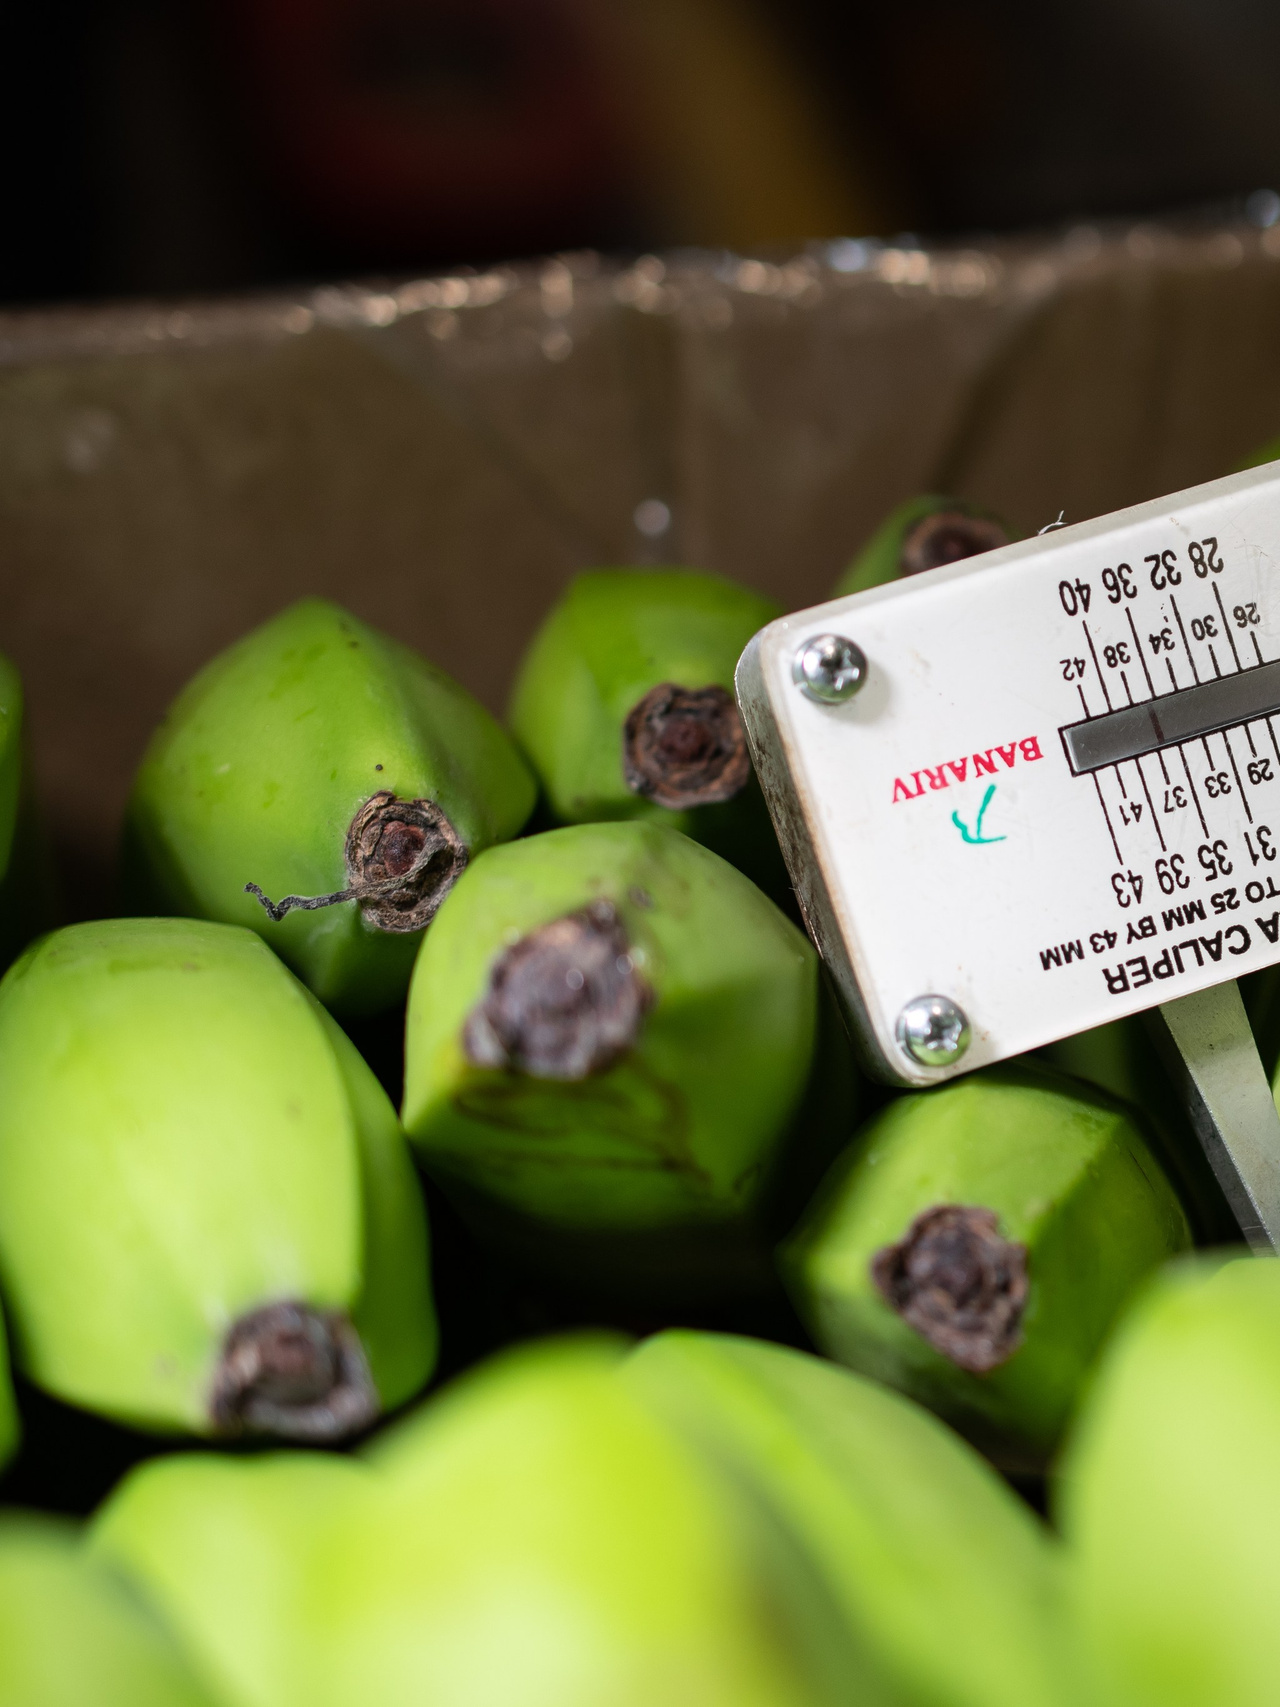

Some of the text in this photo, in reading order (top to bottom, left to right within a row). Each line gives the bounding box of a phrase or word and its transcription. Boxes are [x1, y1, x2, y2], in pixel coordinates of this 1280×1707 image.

[1058, 537, 1224, 616] 28 32 36 40
[1059, 602, 1261, 681] 26 30 34 38 42
[892, 736, 1044, 804] BANARIV
[1204, 772, 1232, 798] 33
[1247, 758, 1274, 785] 29
[1118, 801, 1143, 826] 41
[1163, 786, 1188, 813] 37
[1197, 839, 1233, 881] 35
[1244, 825, 1277, 866] 31
[1111, 870, 1144, 908] 43
[1155, 854, 1190, 895] 39
[1162, 899, 1206, 931] MM
[1210, 888, 1240, 916] 25
[1090, 930, 1118, 954] 43
[1126, 915, 1157, 944] BY
[1039, 939, 1084, 971] MM
[1102, 925, 1252, 995] CALIPER
